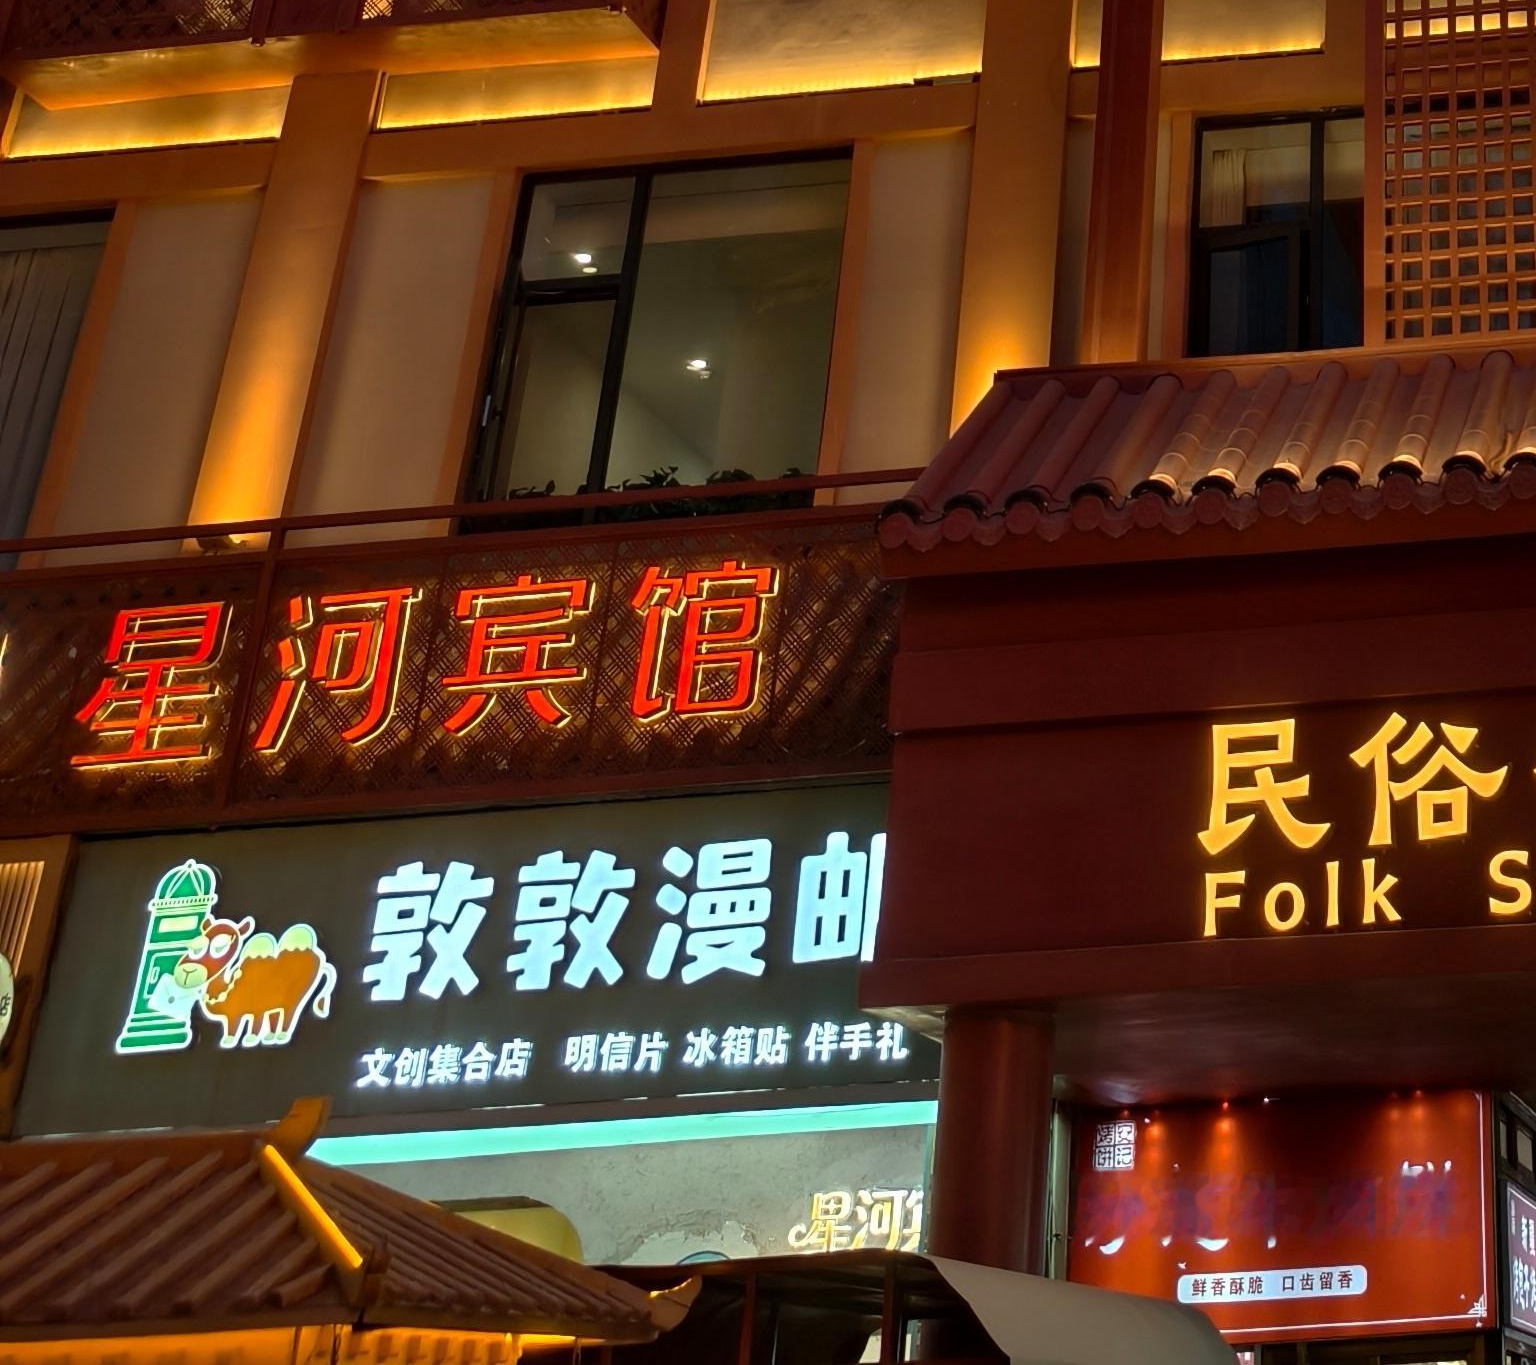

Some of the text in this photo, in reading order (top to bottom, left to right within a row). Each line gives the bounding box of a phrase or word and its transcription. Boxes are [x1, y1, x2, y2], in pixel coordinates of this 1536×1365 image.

[70, 560, 780, 769] 星河宾馆
[1203, 859, 1402, 937] Folk
[355, 1021, 910, 1089] 文创集合店 明信片 冰箱贴 伴手礼
[1191, 1269, 1353, 1297] 鲜香酥脆 口齿留香
